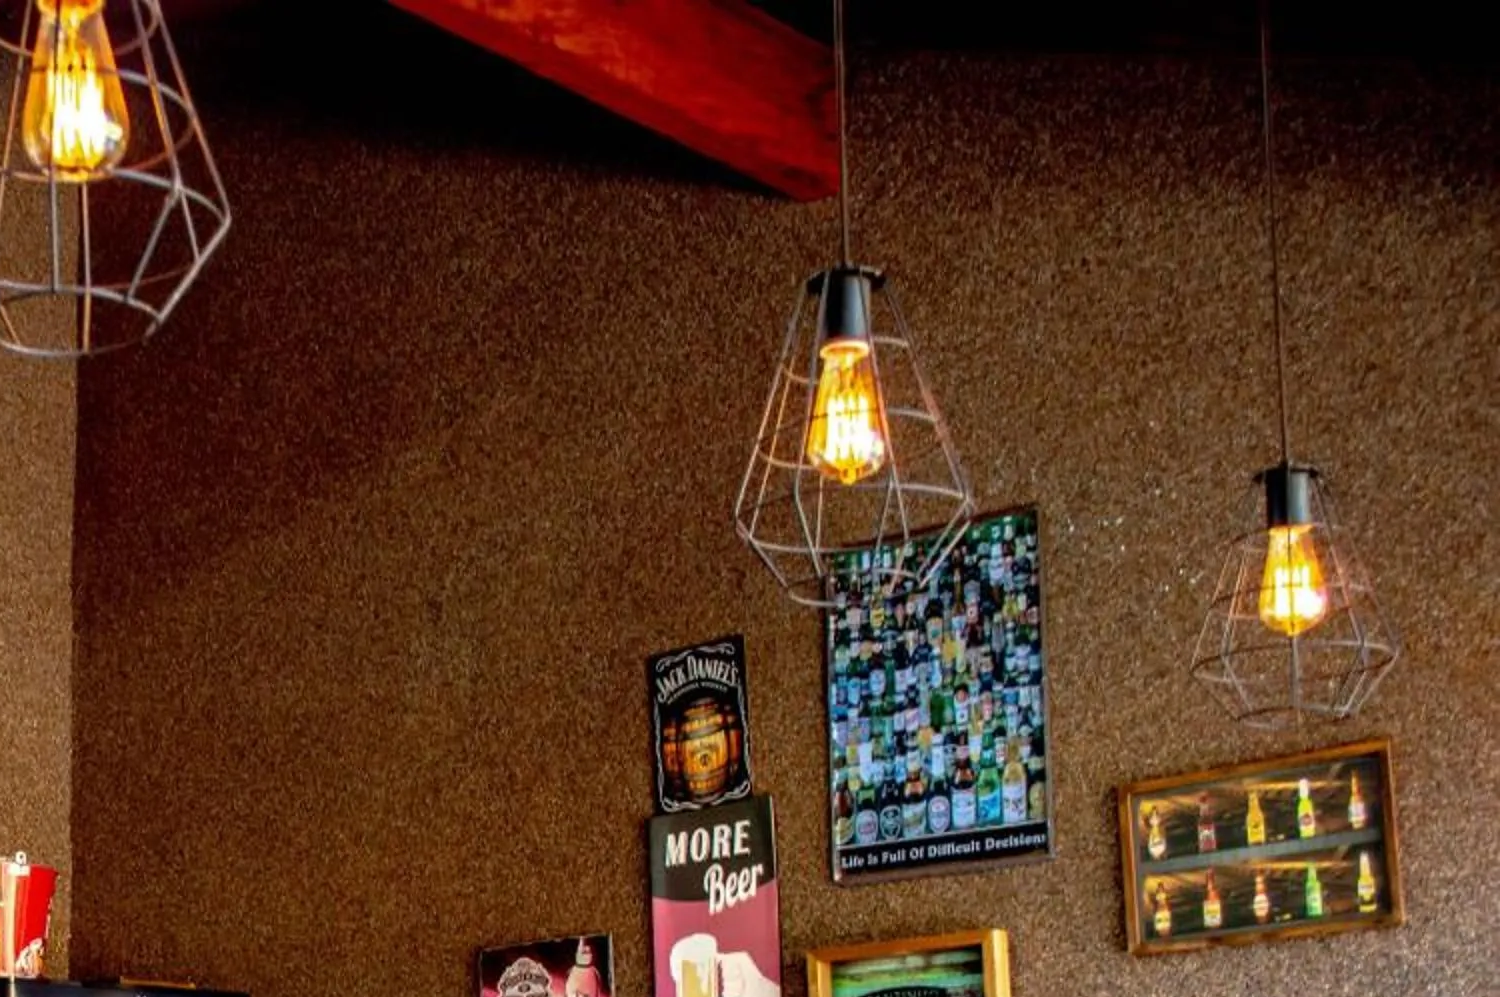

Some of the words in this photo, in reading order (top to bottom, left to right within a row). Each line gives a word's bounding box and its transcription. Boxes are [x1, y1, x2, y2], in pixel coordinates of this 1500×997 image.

[655, 666, 687, 703] JACK
[665, 820, 751, 868] MORE
[841, 856, 865, 869] Life
[867, 852, 879, 865] Is
[882, 848, 906, 864] Full
[909, 847, 924, 860] Of
[927, 839, 981, 856] Difficult
[703, 863, 764, 916] Beer
